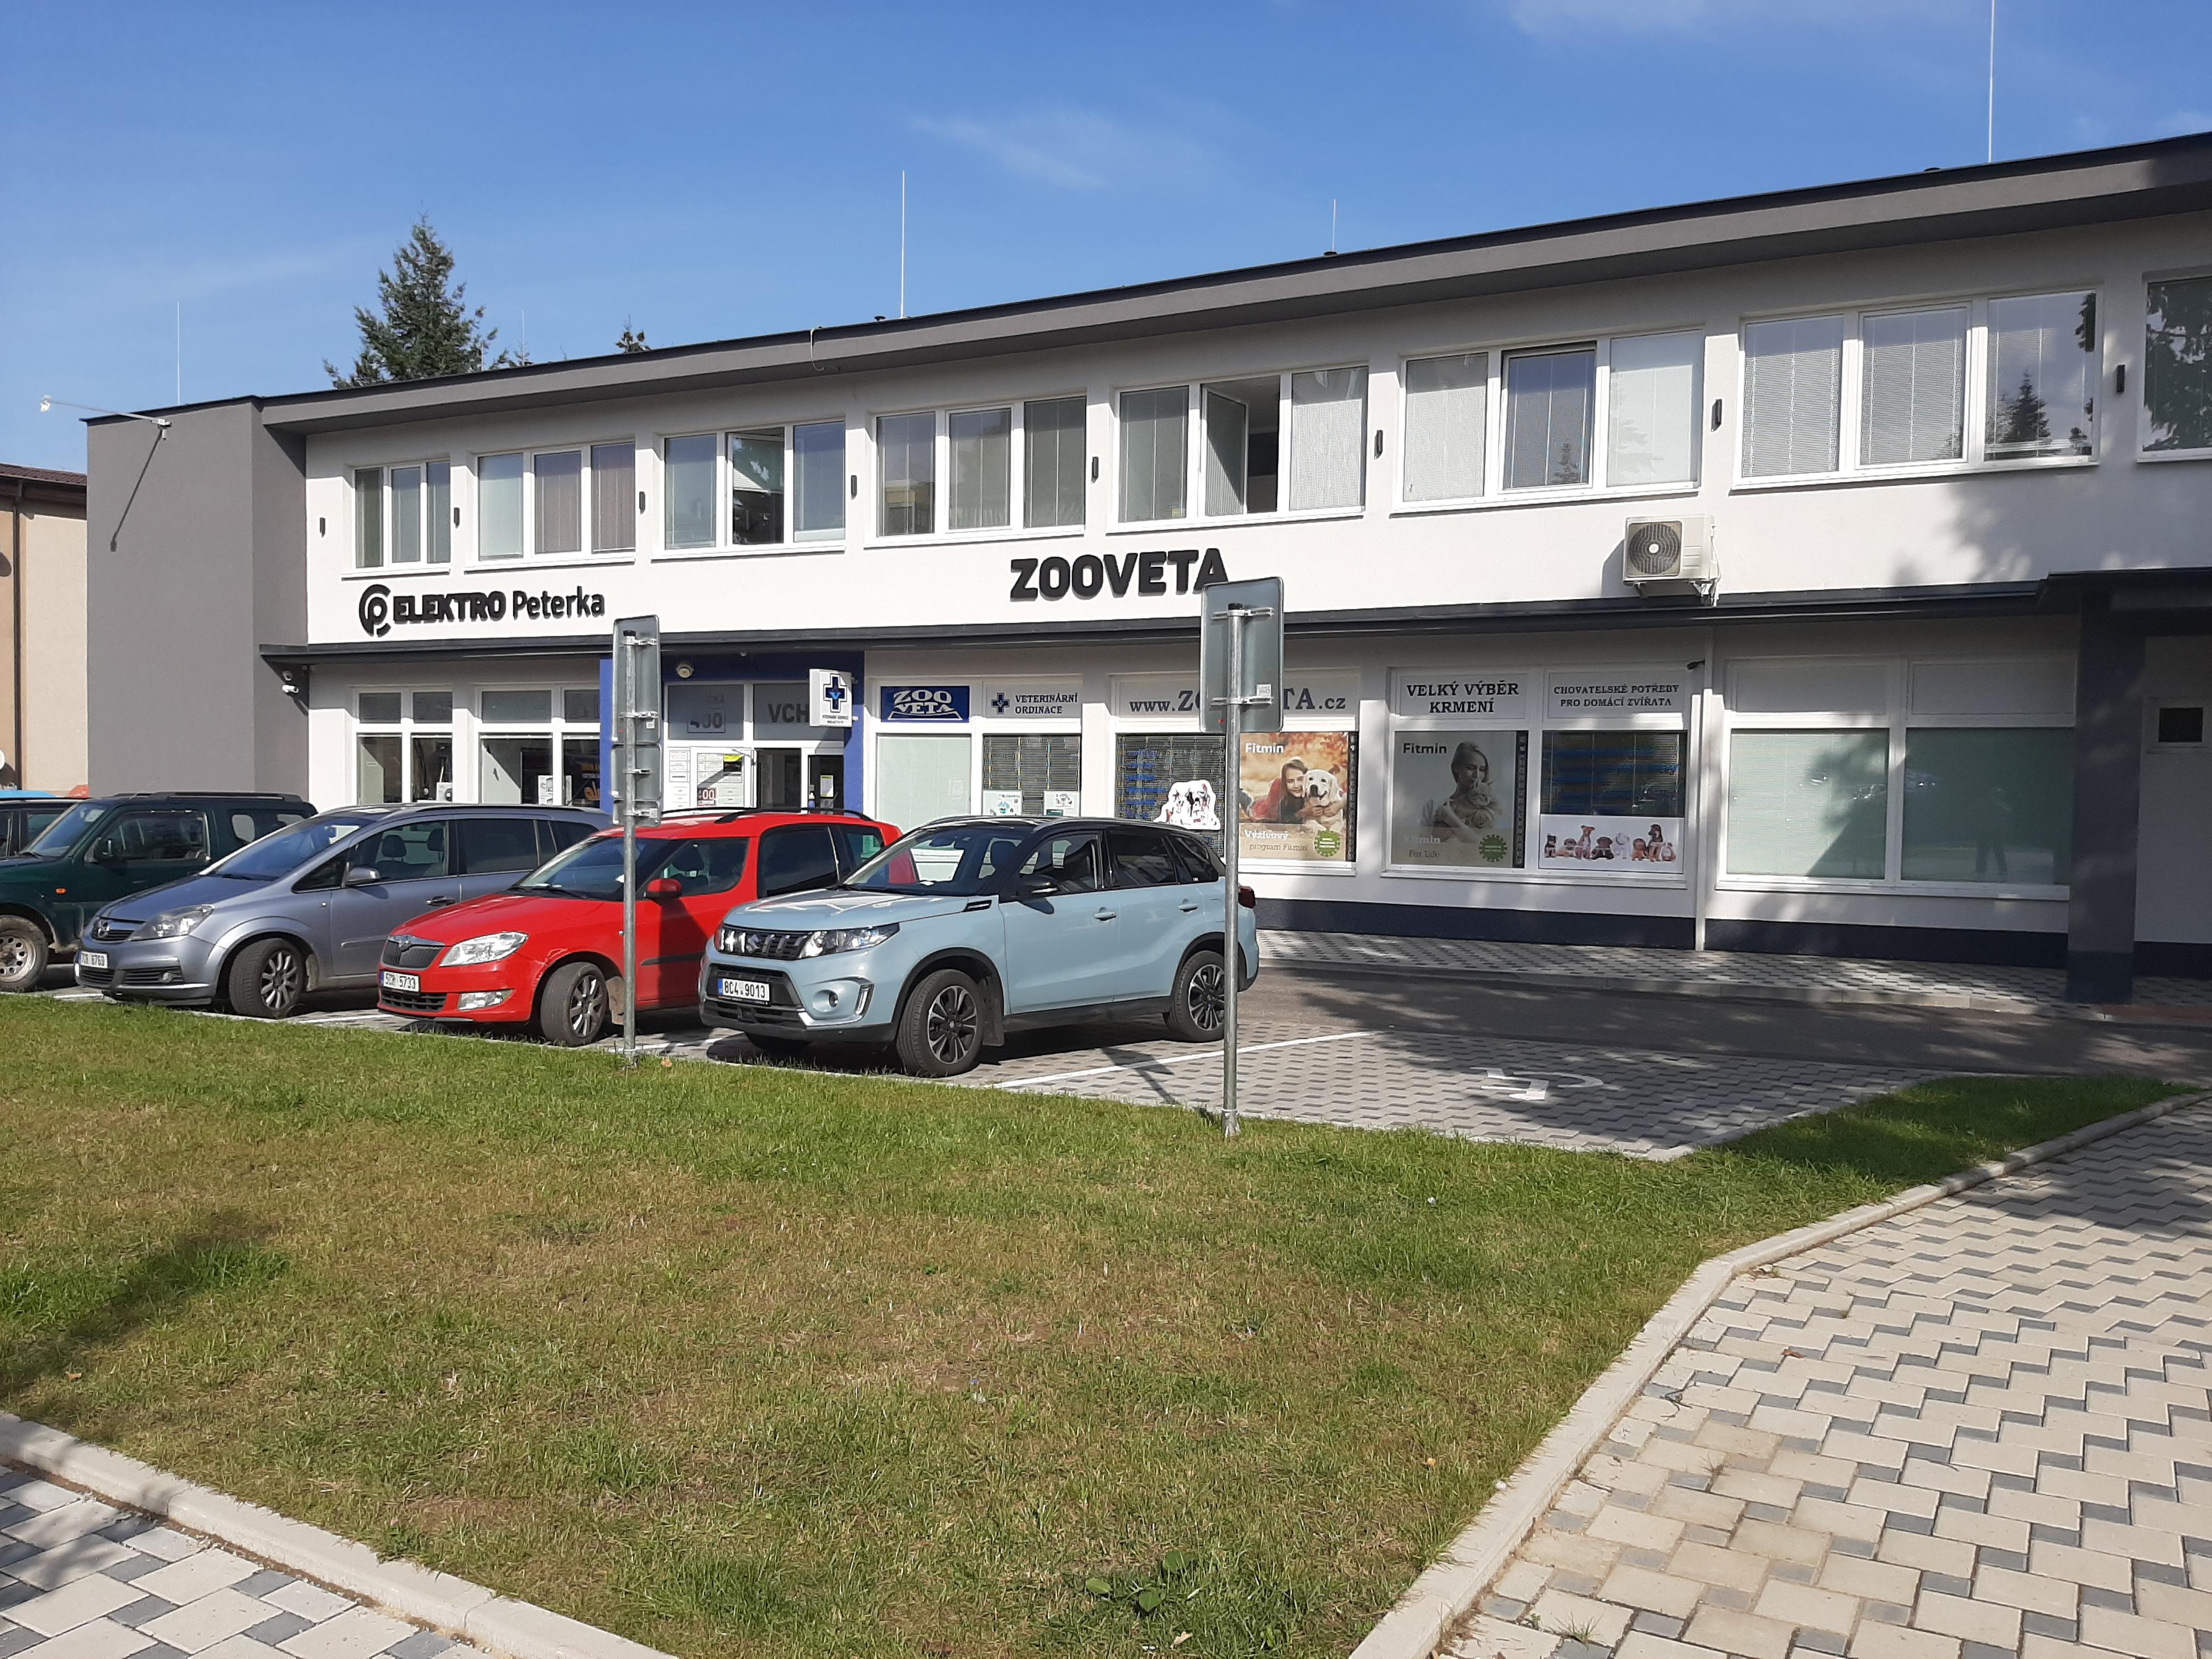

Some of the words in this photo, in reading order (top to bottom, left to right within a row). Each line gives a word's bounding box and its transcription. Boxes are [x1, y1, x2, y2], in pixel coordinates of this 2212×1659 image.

[1010, 548, 1229, 602] ZOOVETA
[393, 591, 506, 624] ELEKTRO
[512, 586, 605, 620] Peterka
[1406, 681, 1459, 696] VELKÝ
[1464, 680, 1519, 695] VÝBĚR
[1554, 684, 1627, 694] CHOVATELSKÉ
[1631, 684, 1679, 693] POTŘEBY
[894, 690, 952, 704] ZOO
[1015, 692, 1078, 703] VETERINÁRNÍ
[1583, 696, 1624, 707] DOMÁCÍ
[1627, 696, 1671, 706] ZVÍŘATA
[894, 702, 955, 714] VETA
[1429, 697, 1494, 713] KRMENÍ
[1245, 743, 1284, 753] Fitmin
[1404, 743, 1447, 753] Fitmin
[724, 980, 738, 995] 8C4
[745, 983, 765, 999] 9013
